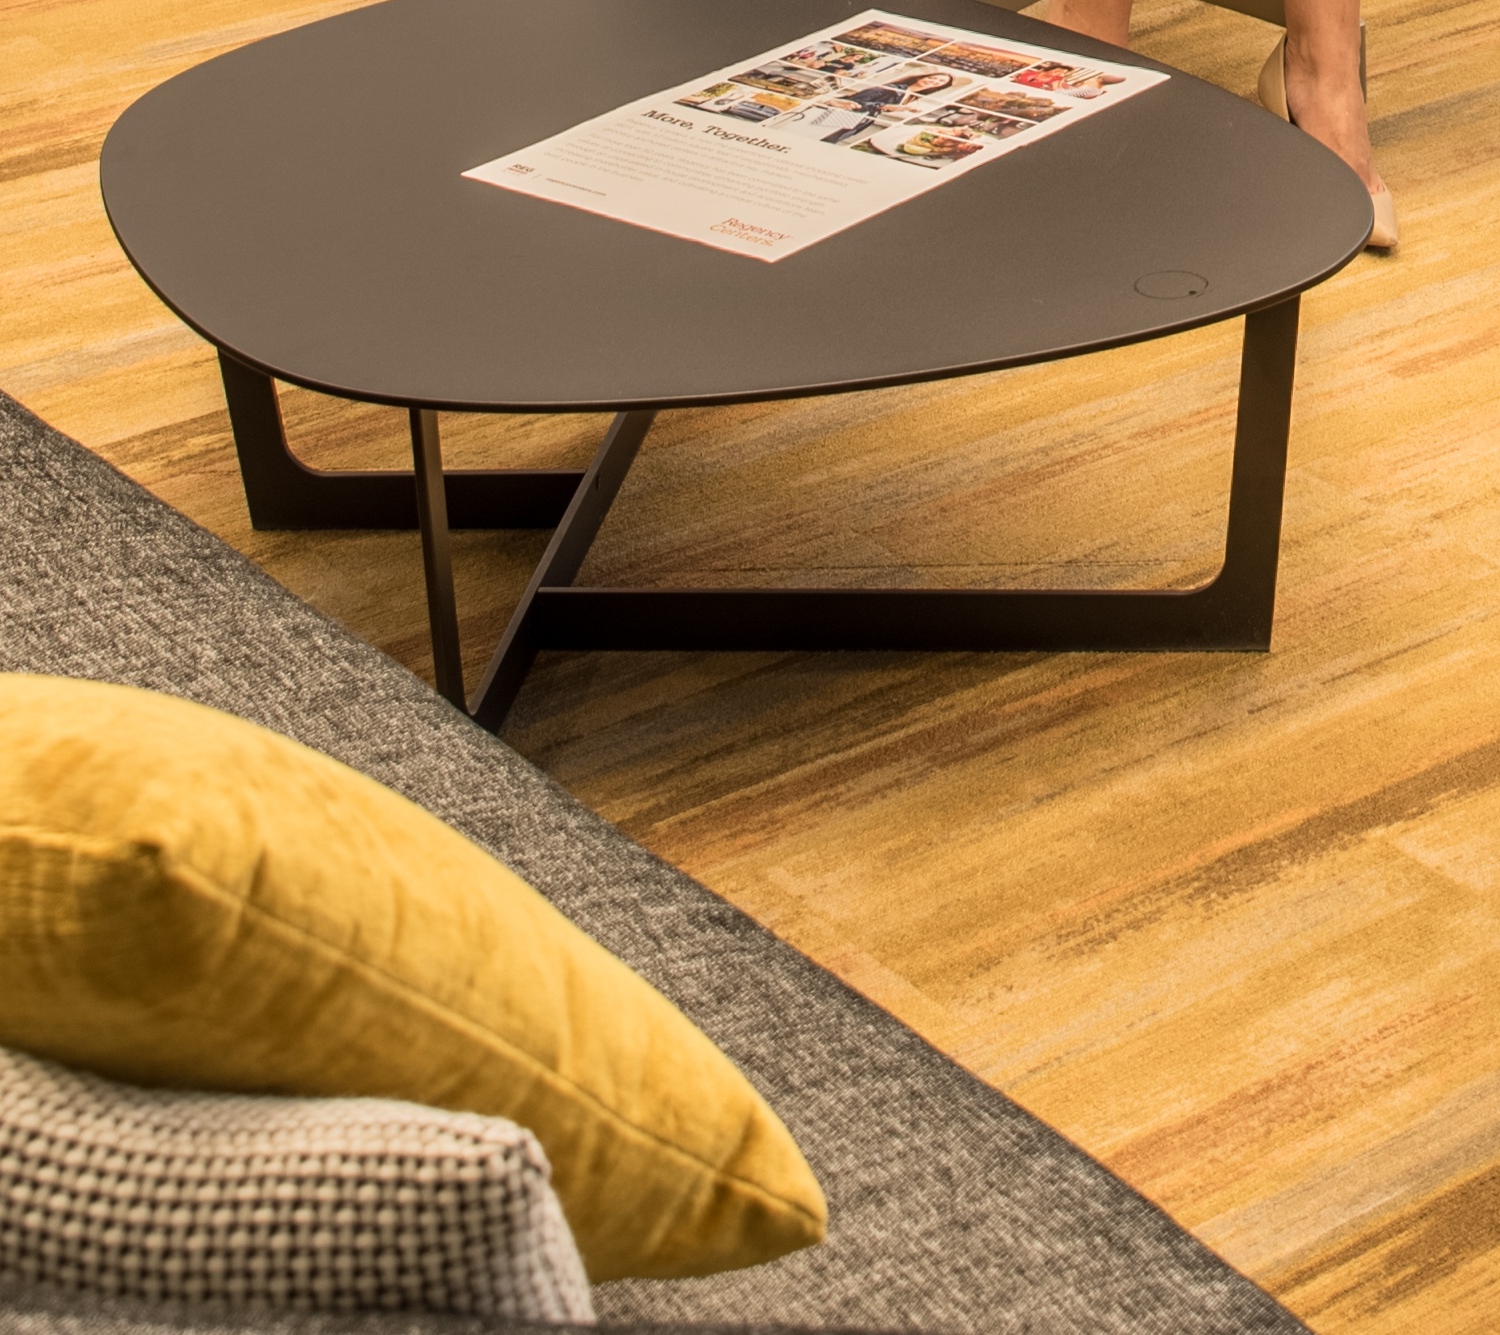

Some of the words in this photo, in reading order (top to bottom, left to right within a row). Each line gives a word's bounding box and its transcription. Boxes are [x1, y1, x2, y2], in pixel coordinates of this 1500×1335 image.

[640, 109, 694, 131] More,
[702, 125, 792, 154] Together.
[709, 223, 774, 246] Centers.
[720, 216, 790, 241] Regency
